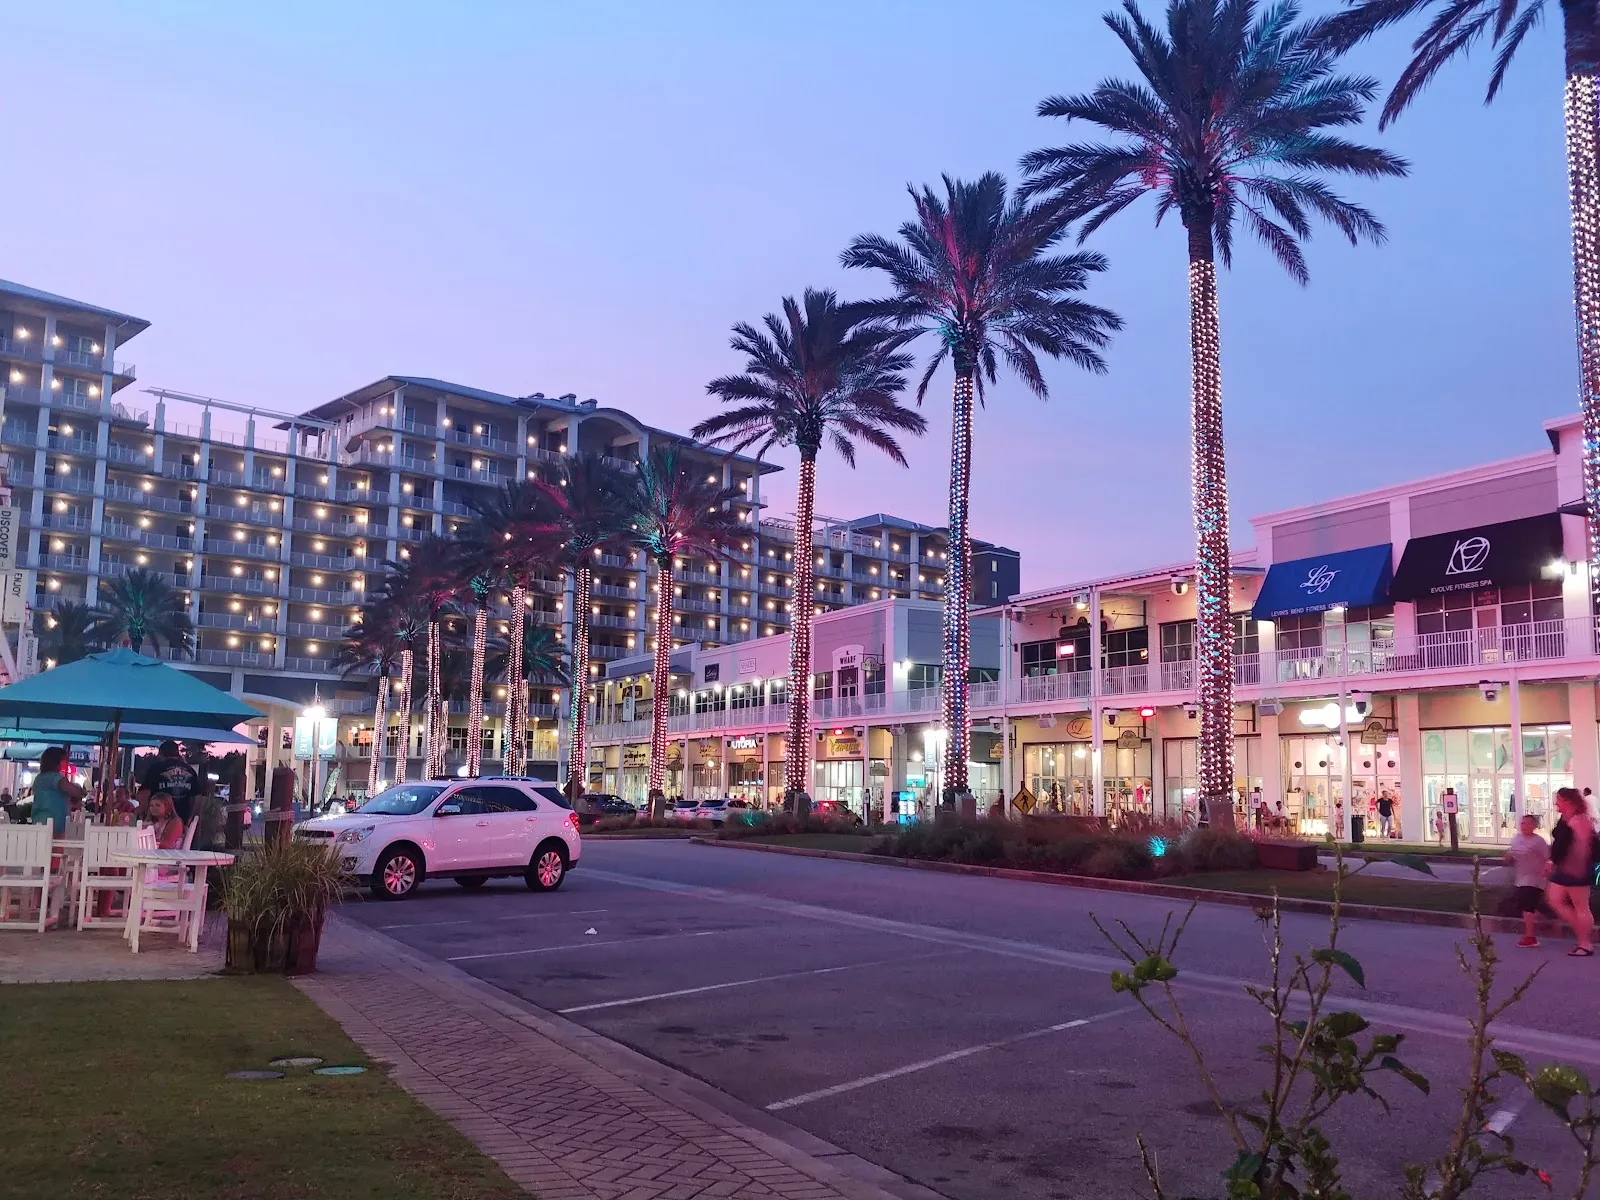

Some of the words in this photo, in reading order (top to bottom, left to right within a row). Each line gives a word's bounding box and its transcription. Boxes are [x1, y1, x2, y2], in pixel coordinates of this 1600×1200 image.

[12, 572, 23, 597] ENJOY
[1430, 584, 1454, 593] EVOLVE
[1454, 580, 1479, 590] FITNESS
[1479, 579, 1493, 587] SPA
[1290, 607, 1305, 615] BEND
[1305, 604, 1327, 613] FITNESS
[731, 739, 757, 749] UTOPIA
